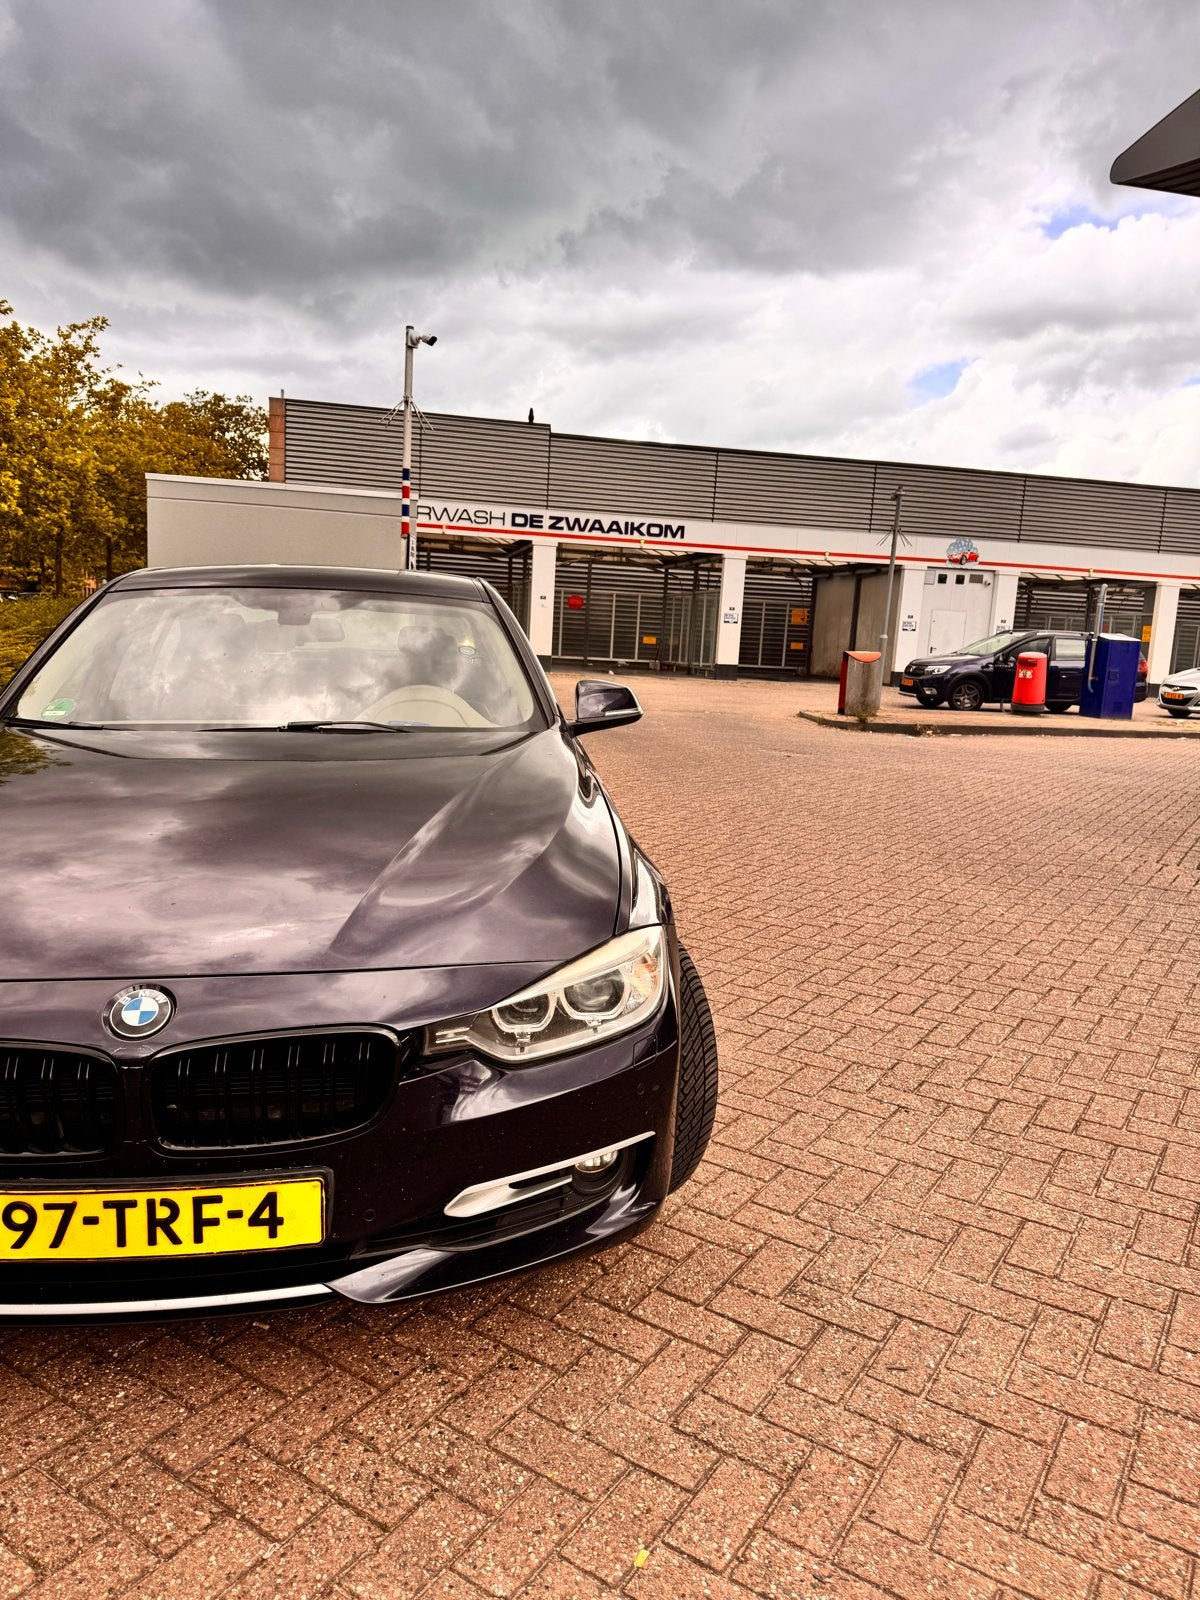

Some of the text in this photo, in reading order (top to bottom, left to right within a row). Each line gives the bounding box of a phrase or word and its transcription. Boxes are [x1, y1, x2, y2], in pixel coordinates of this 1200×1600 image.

[511, 513, 544, 529] DE
[548, 515, 685, 539] ZWAAIKOM
[119, 990, 169, 1006] BMW
[2, 1191, 285, 1250] 97-TRF-4
